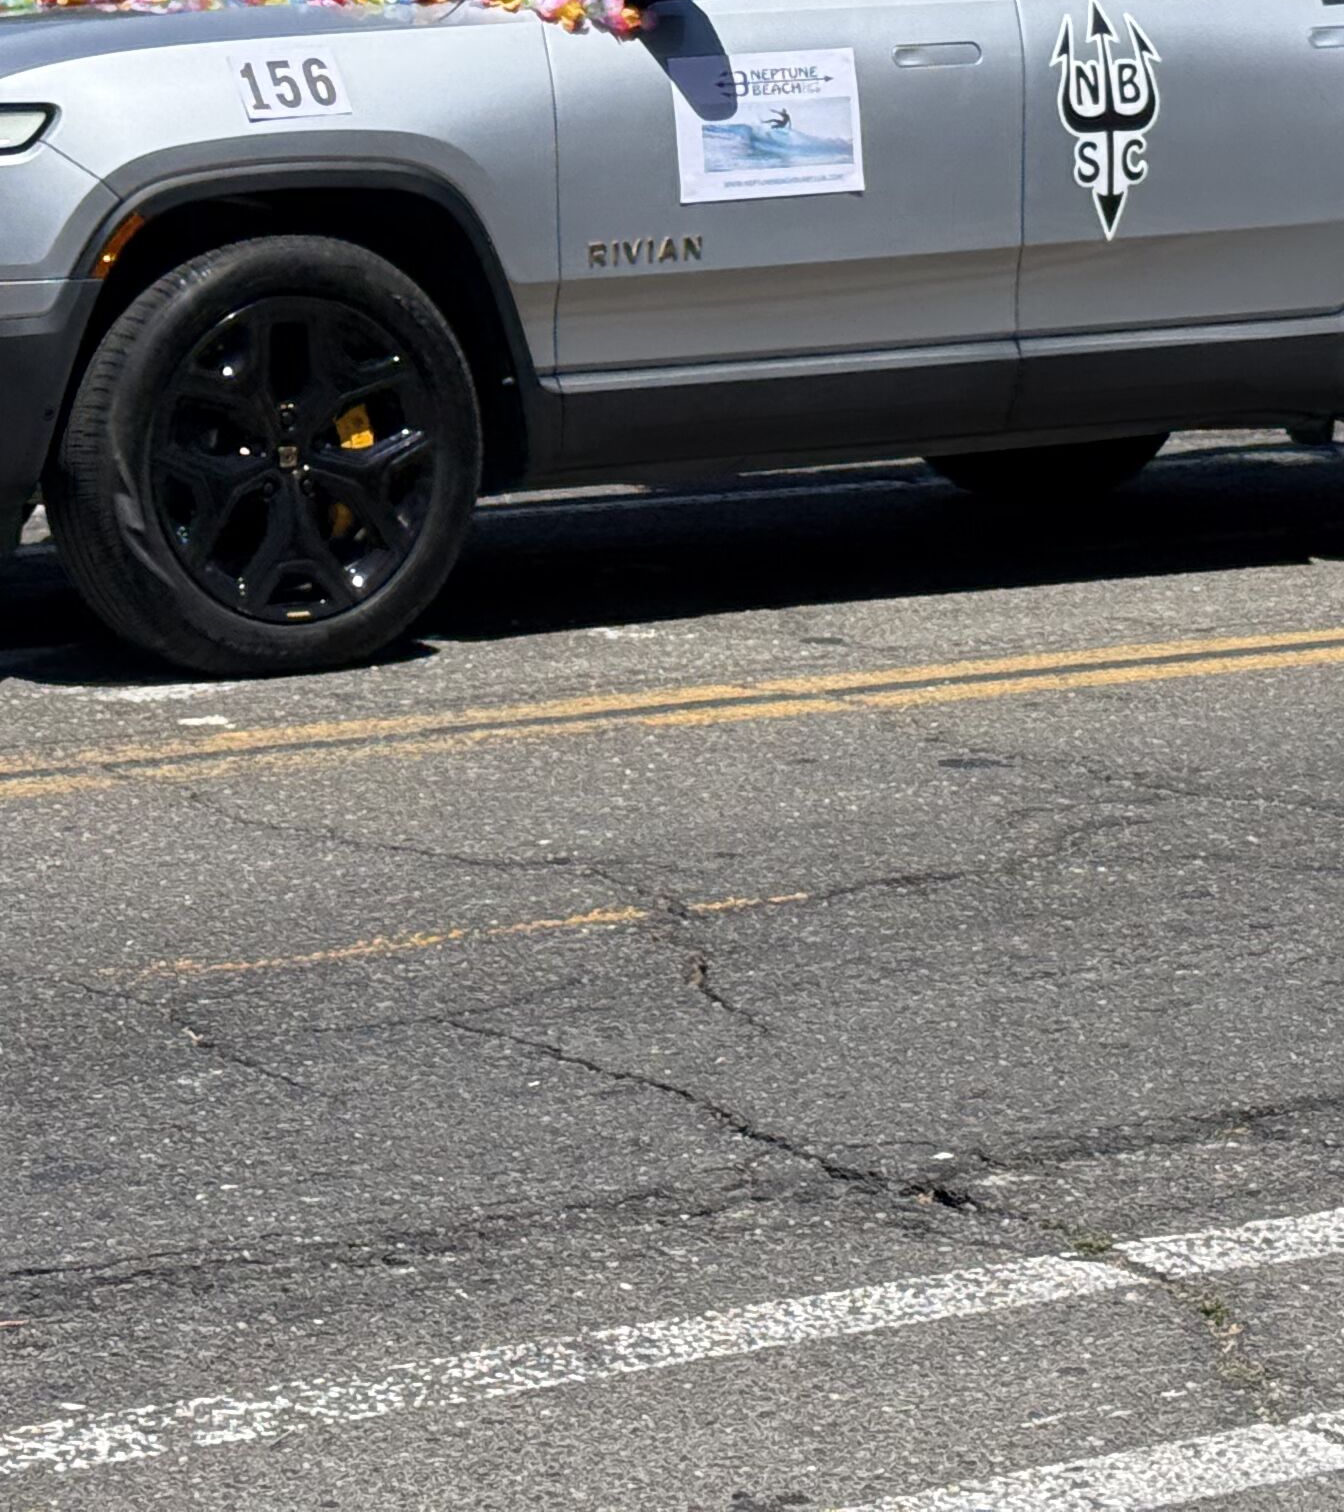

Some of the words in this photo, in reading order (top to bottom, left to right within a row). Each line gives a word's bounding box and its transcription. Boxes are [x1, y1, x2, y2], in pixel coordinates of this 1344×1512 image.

[239, 56, 338, 110] 156
[750, 65, 819, 82] NEPTUNE
[752, 82, 803, 97] BEACH
[585, 234, 704, 268] RIVIAN
